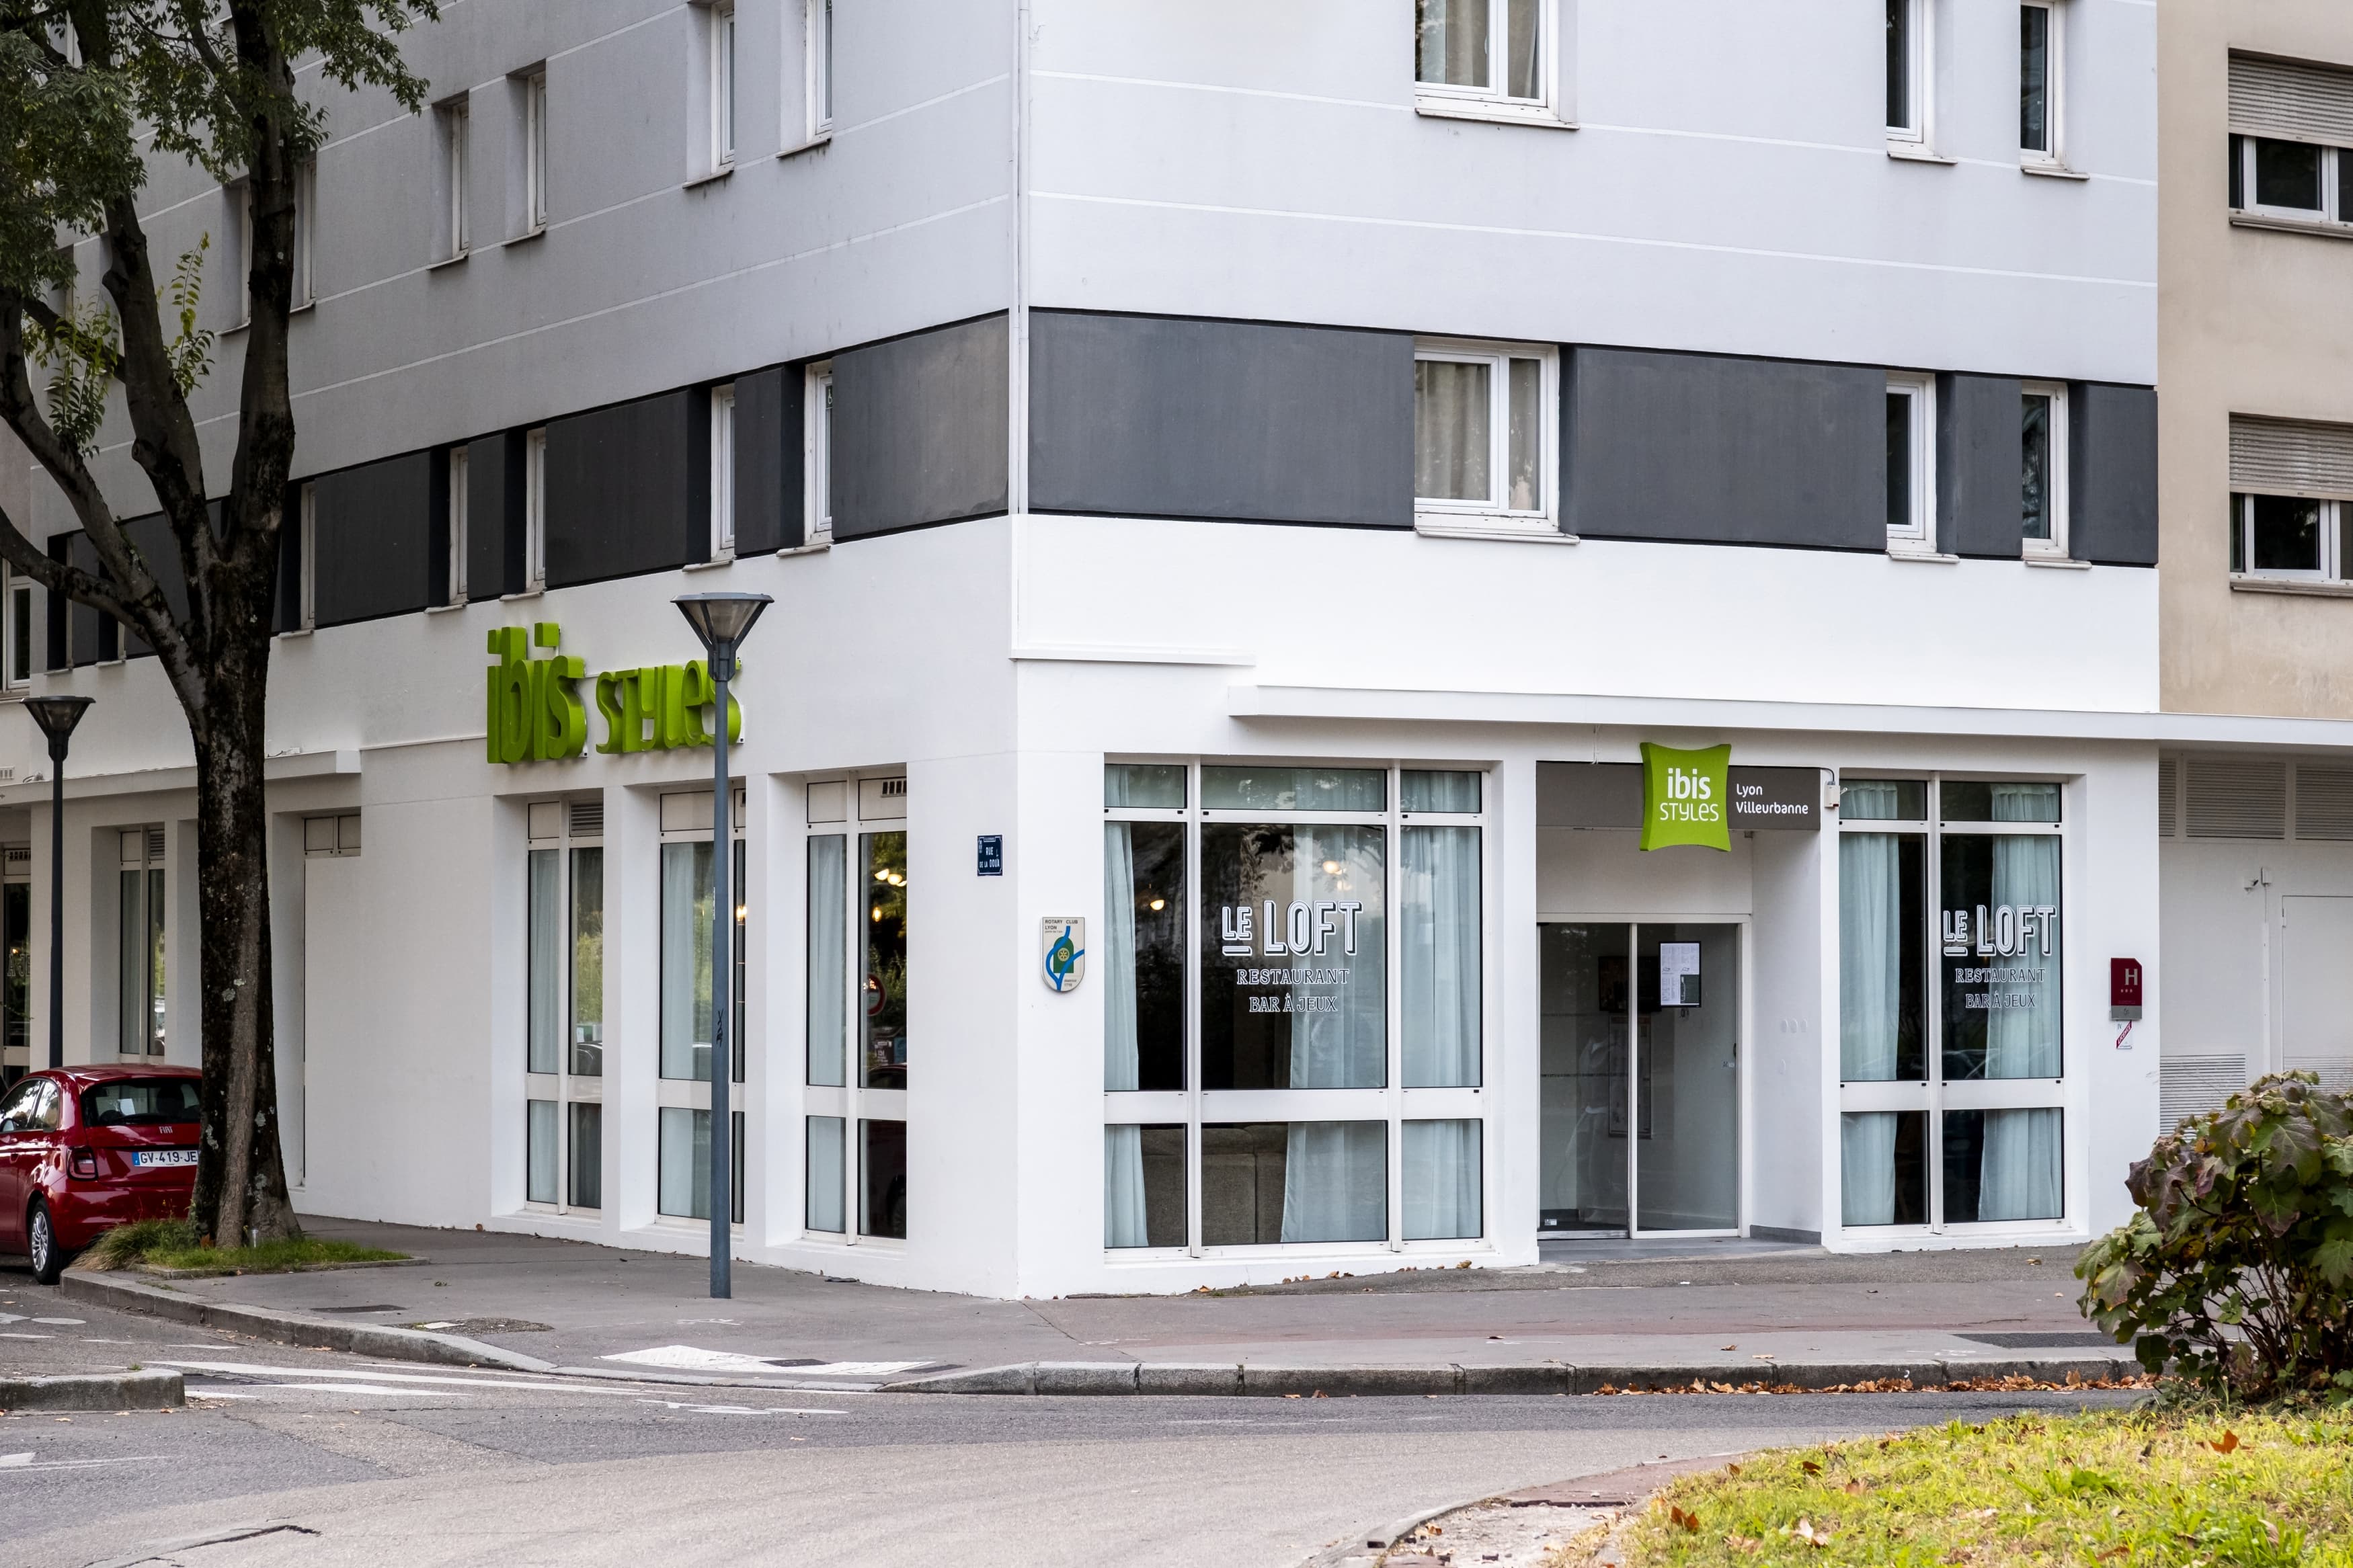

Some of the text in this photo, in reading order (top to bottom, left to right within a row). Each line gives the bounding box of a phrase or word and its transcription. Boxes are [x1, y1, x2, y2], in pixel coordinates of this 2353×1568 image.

[487, 622, 587, 764] ibis
[1667, 768, 1711, 800] ibis
[1736, 783, 1763, 798] Lyon
[1736, 801, 1808, 815] Villeurbanne
[1222, 900, 1363, 956] LE LOFT
[1943, 905, 2057, 956] LE LOFT
[1237, 968, 1350, 985] RESTAURANT
[1955, 968, 2046, 983] RESTAURANT
[2124, 968, 2138, 985] H
[1249, 992, 1338, 1012] BAR À JEUX
[1966, 990, 2036, 1008] BAR À JEUX
[159, 1126, 173, 1134] FIAT
